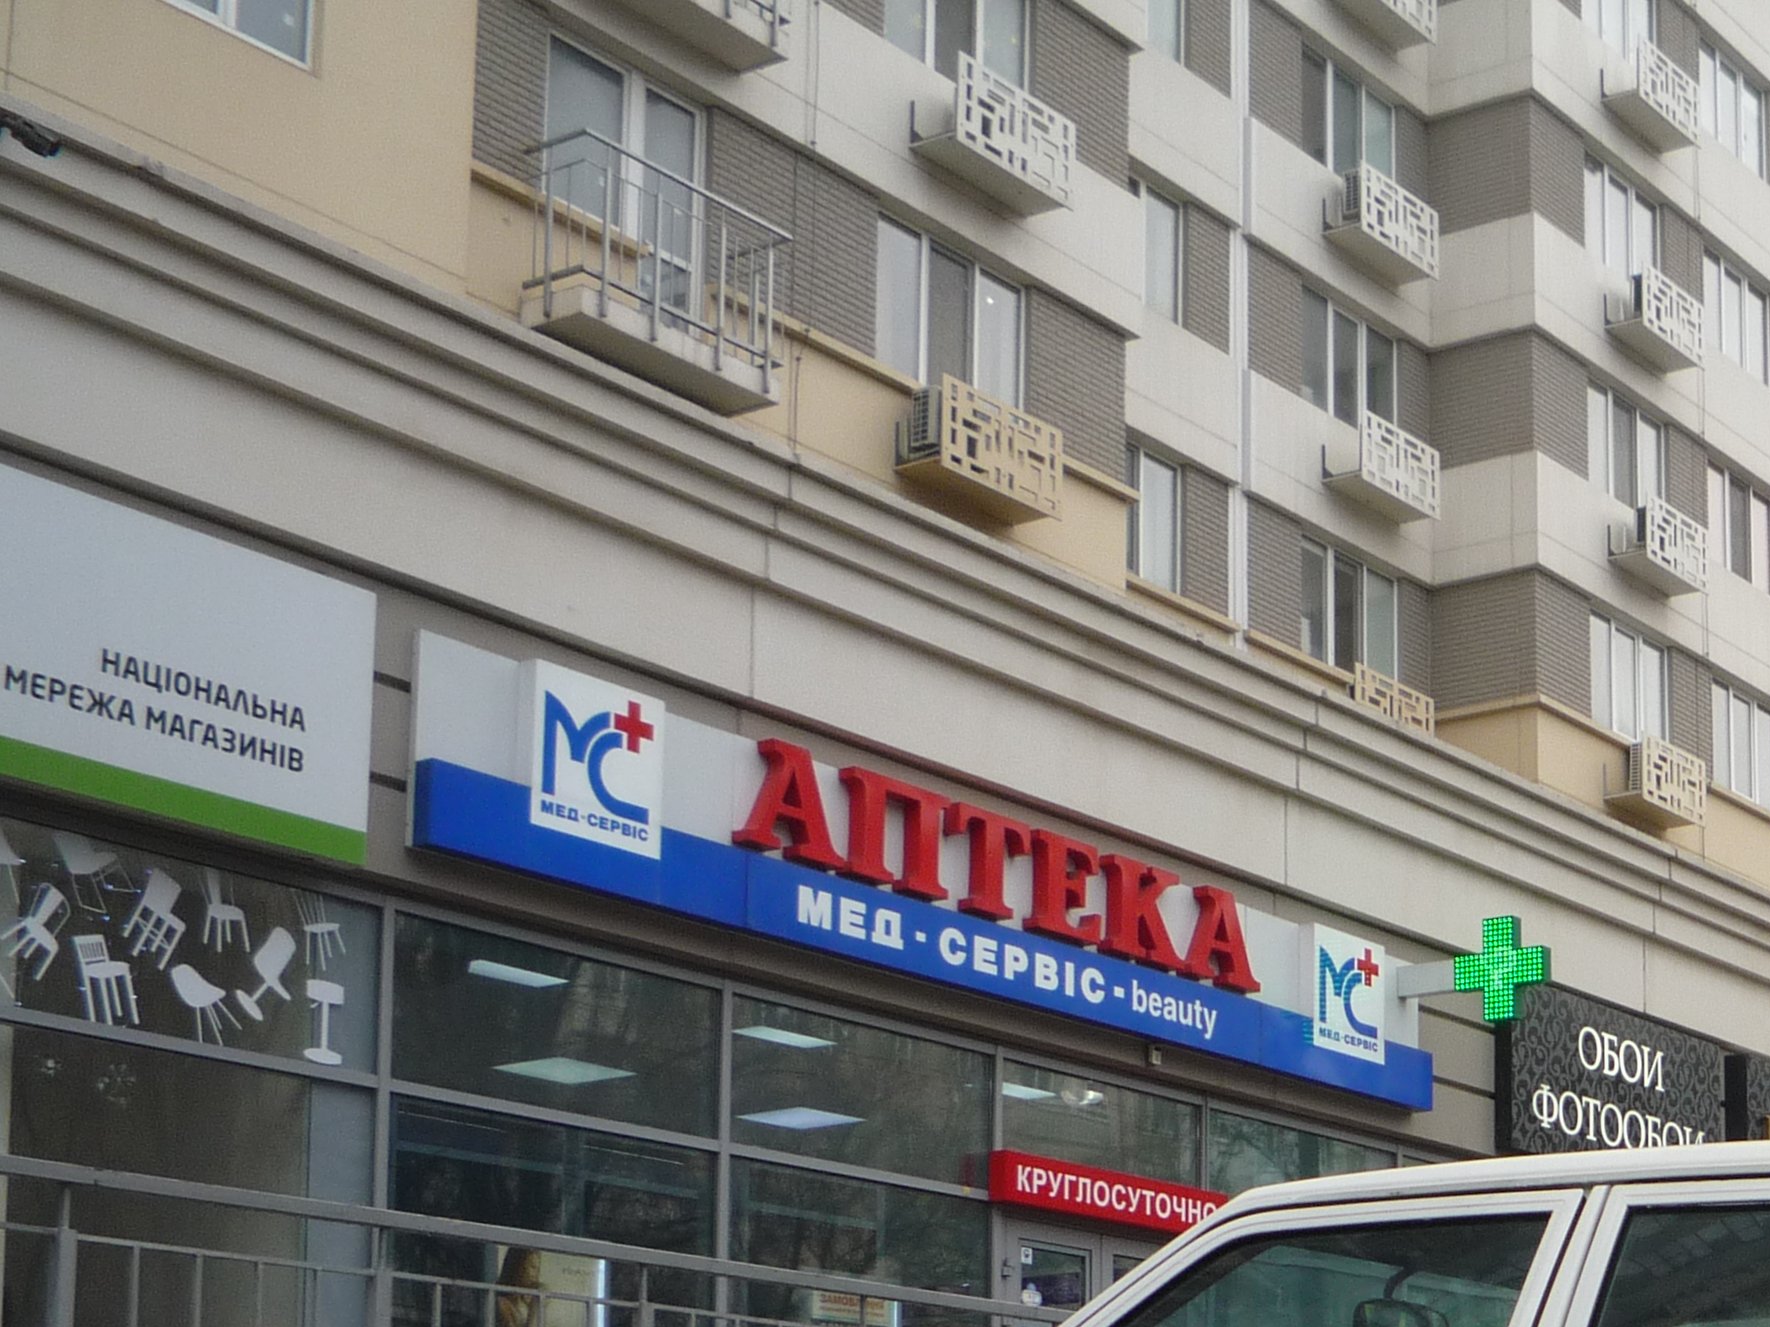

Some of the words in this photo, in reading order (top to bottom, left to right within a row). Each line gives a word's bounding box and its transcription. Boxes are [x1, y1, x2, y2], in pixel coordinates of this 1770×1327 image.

[4, 665, 135, 726] МЕРЕЖА
[146, 705, 304, 773] МАГАЗИНІВ
[102, 648, 306, 732] НАЦІОНАЛЬНА
[732, 737, 1261, 993] АПТЕКА
[1132, 979, 1218, 1039] beauty
[1578, 1026, 1665, 1093] ОБОИ
